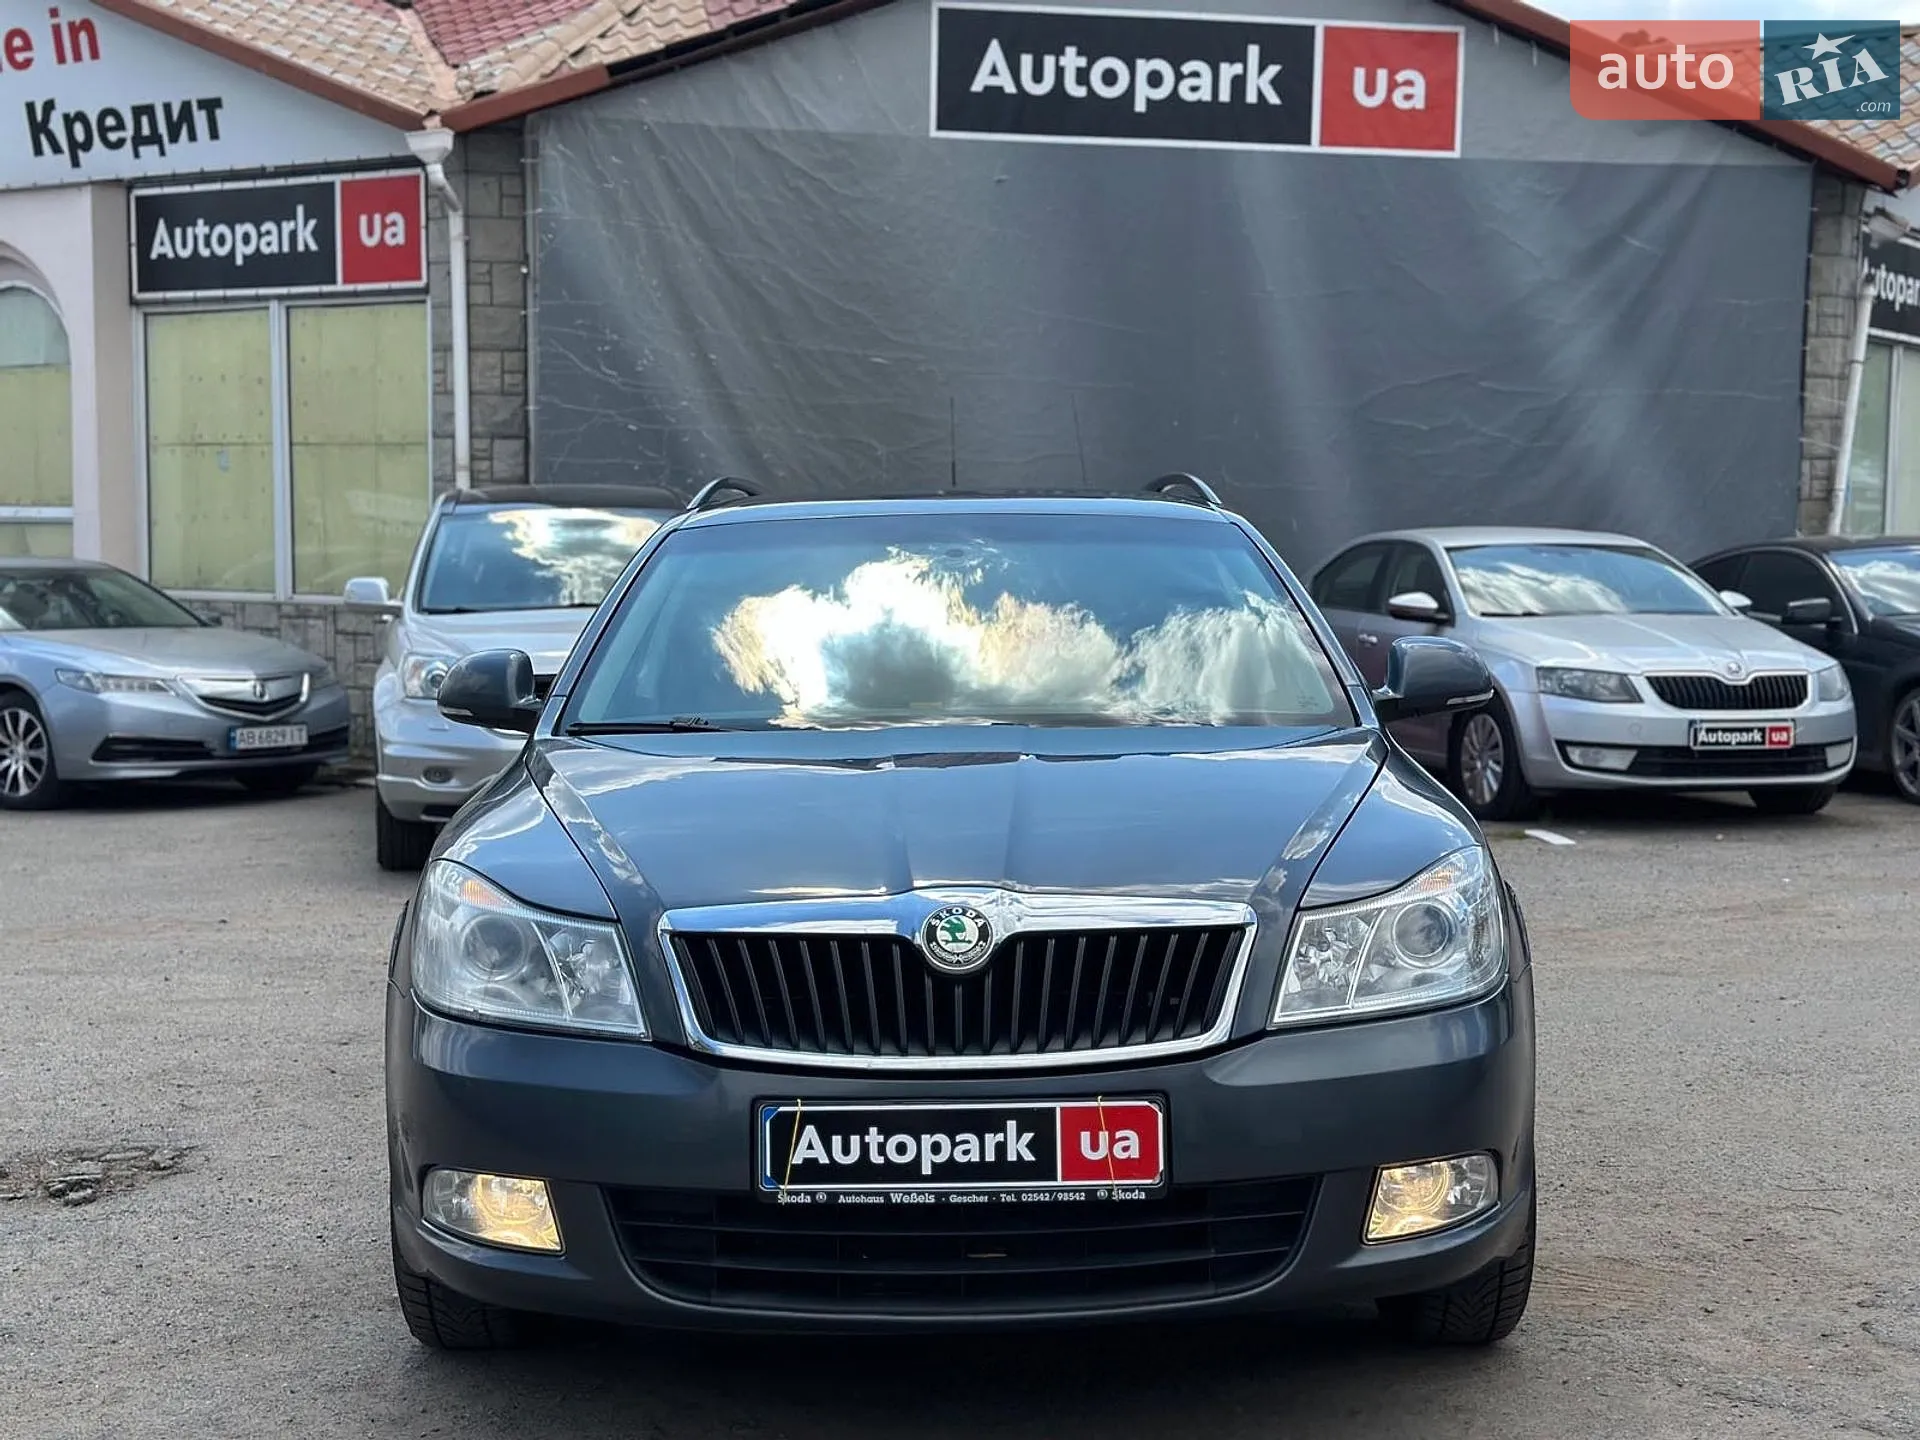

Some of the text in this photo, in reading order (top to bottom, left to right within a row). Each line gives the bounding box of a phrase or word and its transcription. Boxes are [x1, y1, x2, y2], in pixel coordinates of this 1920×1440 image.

[0, 7, 100, 73] e in
[970, 38, 1426, 113] Autopark ua
[25, 97, 223, 168] Кредит
[150, 205, 406, 265] Autopark ua
[1698, 728, 1788, 745] Autopark ua
[791, 1120, 1141, 1176] Autopark ua
[838, 1194, 885, 1204] Autohaus
[890, 1192, 936, 1204] Weßels
